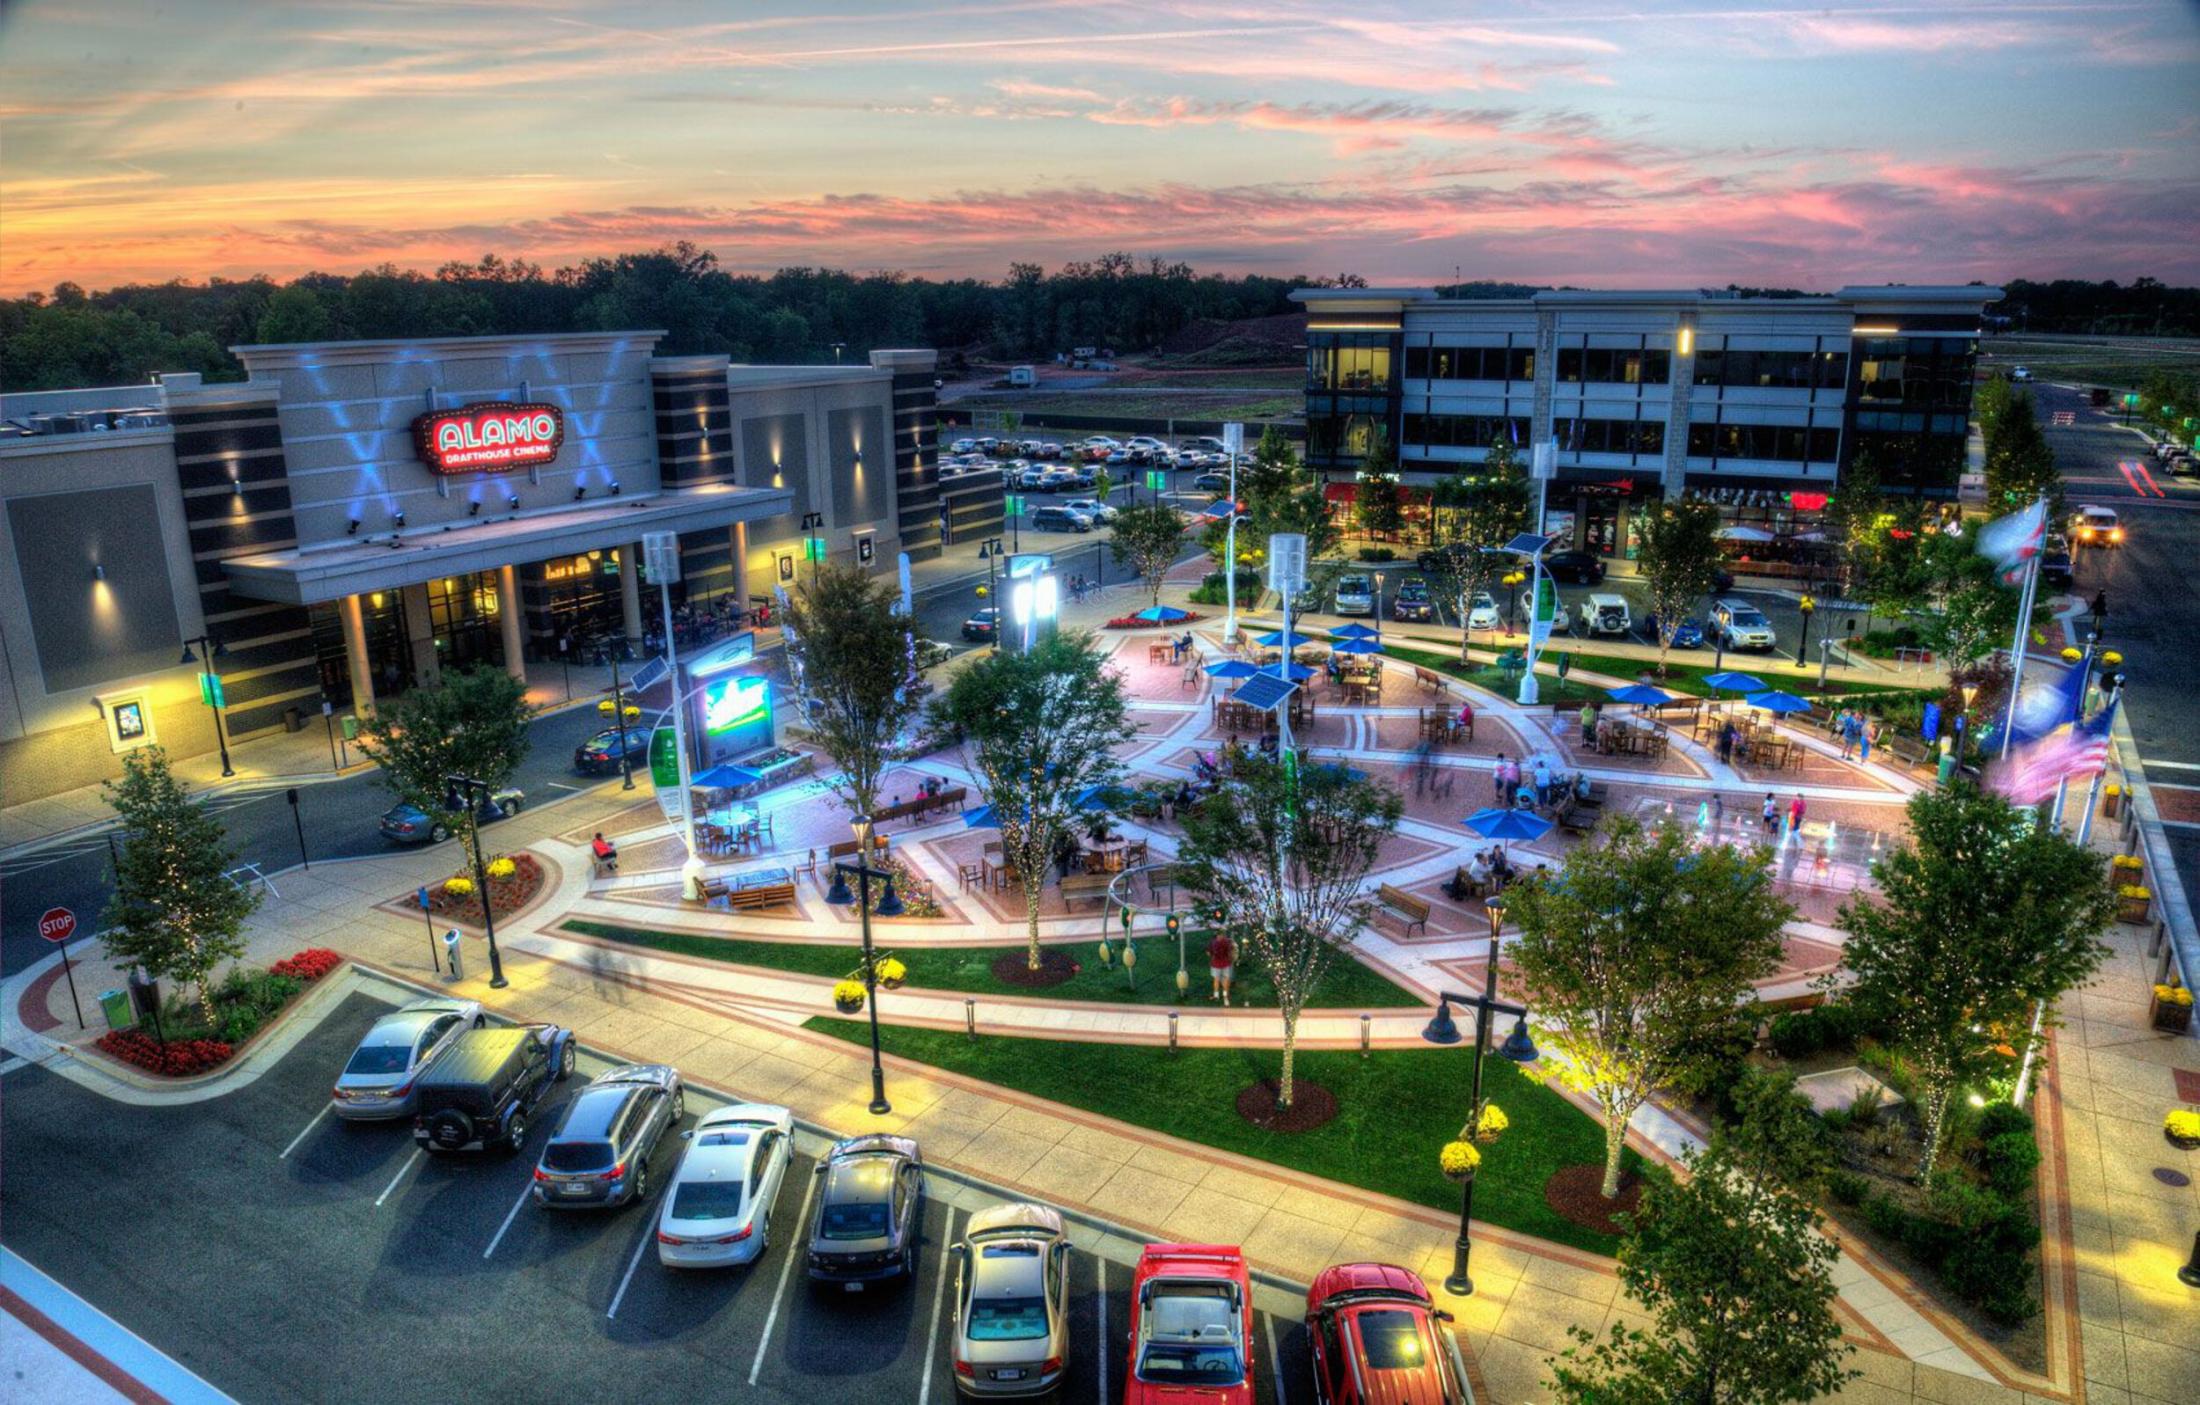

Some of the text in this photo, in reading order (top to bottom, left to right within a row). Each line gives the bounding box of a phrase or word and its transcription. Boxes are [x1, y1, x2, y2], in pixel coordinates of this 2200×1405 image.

[439, 414, 555, 452] ALAMO
[445, 444, 550, 464] DRAFTHOUSE CINEMA
[42, 915, 72, 934] STOP
